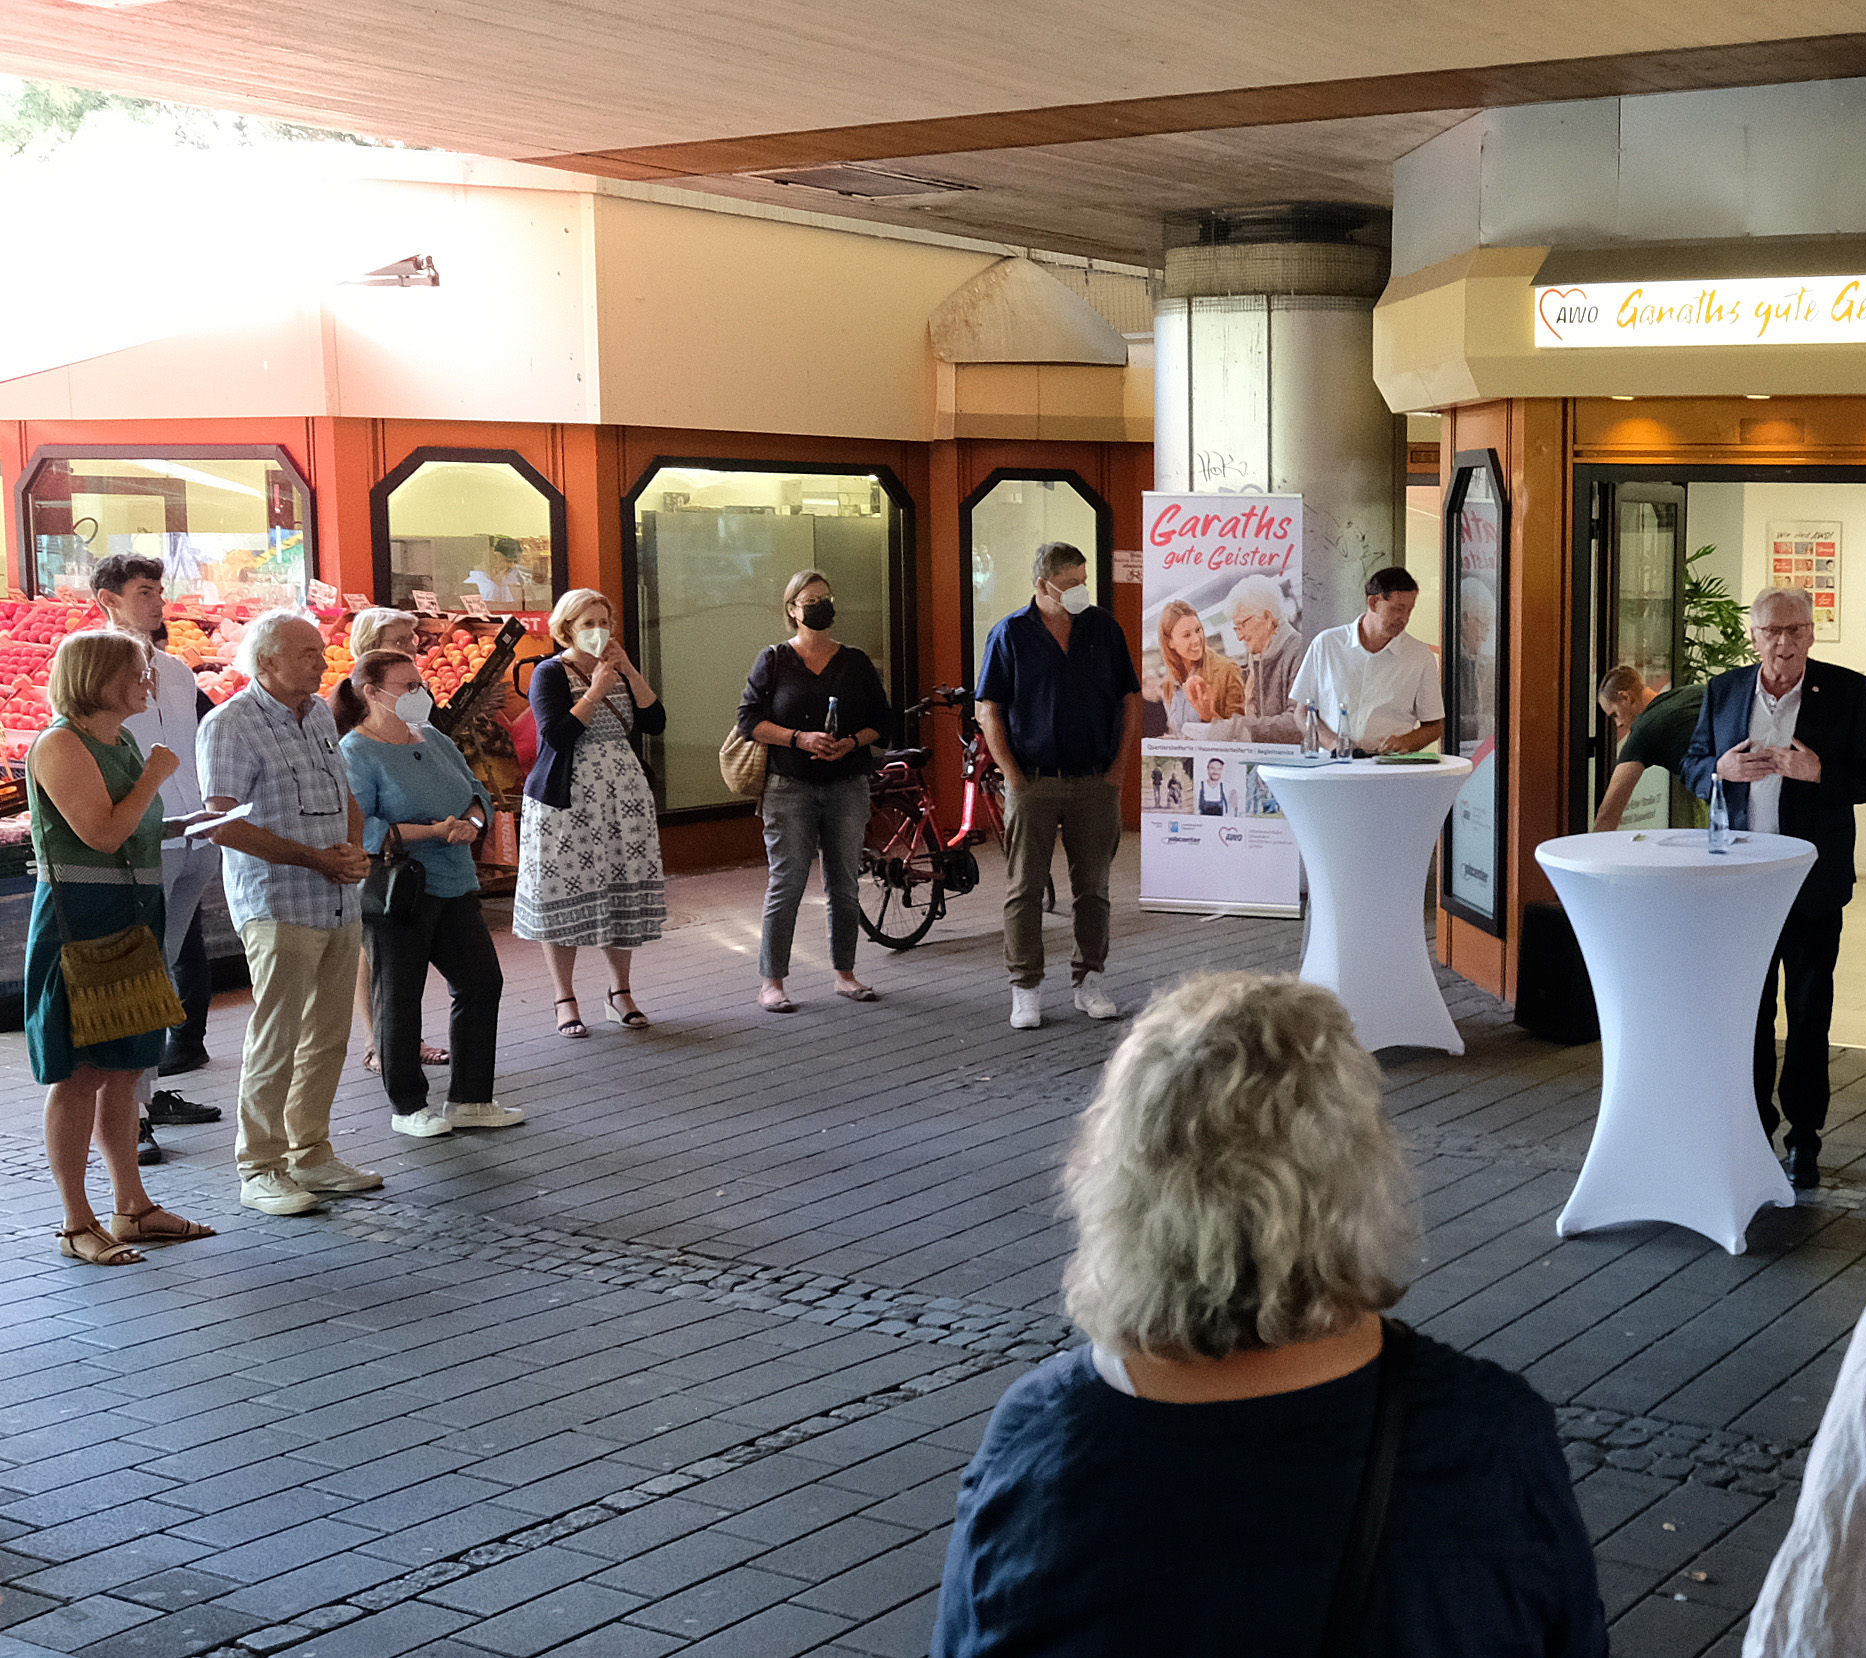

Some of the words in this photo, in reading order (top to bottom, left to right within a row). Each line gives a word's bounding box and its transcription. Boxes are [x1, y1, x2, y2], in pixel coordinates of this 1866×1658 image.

[1556, 305, 1599, 325] AWO
[1616, 288, 1740, 329] Garaths
[1753, 285, 1820, 339] gute
[1149, 503, 1293, 547] Garaths
[1162, 545, 1204, 570] gute
[1207, 543, 1295, 577] Geister!
